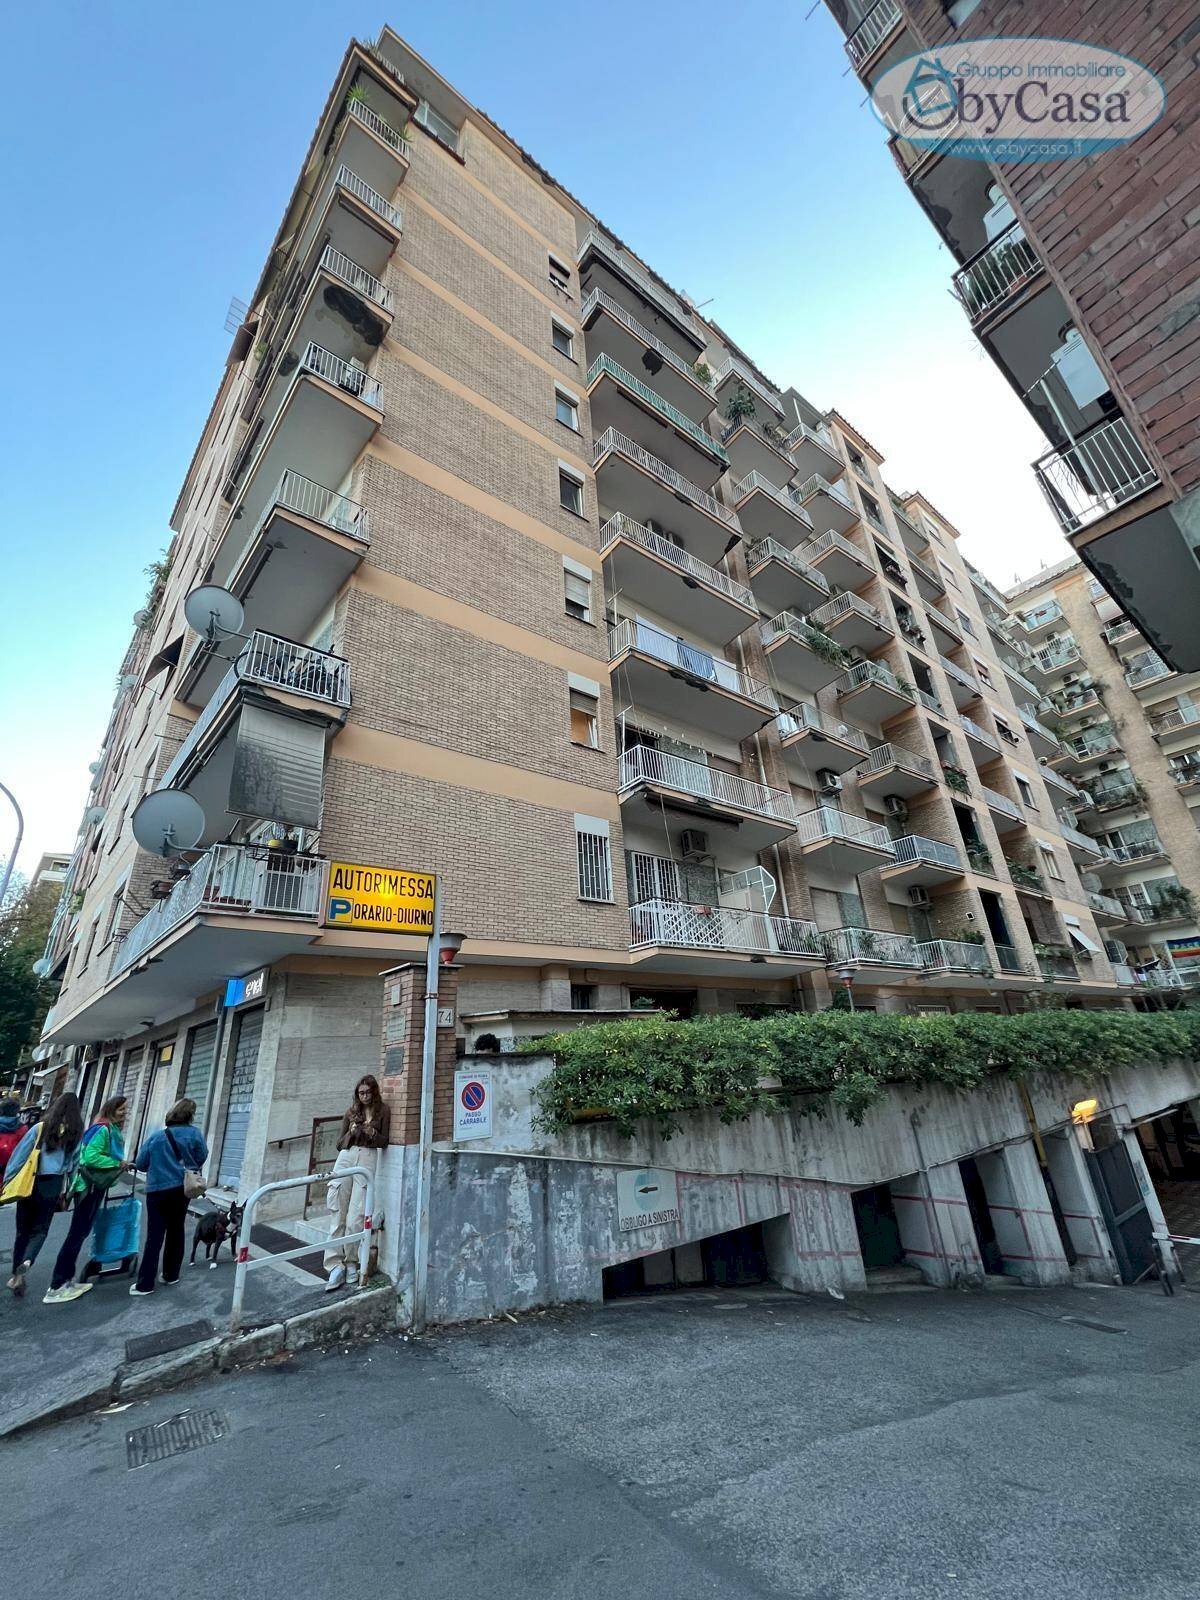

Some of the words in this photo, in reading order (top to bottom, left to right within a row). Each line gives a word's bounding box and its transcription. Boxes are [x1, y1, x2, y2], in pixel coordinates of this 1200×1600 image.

[333, 868, 433, 899] AUTORIMESSA
[329, 899, 351, 920] P
[245, 972, 264, 997] enel
[460, 1117, 487, 1126] CARRABILE
[620, 1214, 647, 1230] OBBLIGO
[647, 1213, 653, 1224] A
[653, 1208, 679, 1224] SINISTRA
